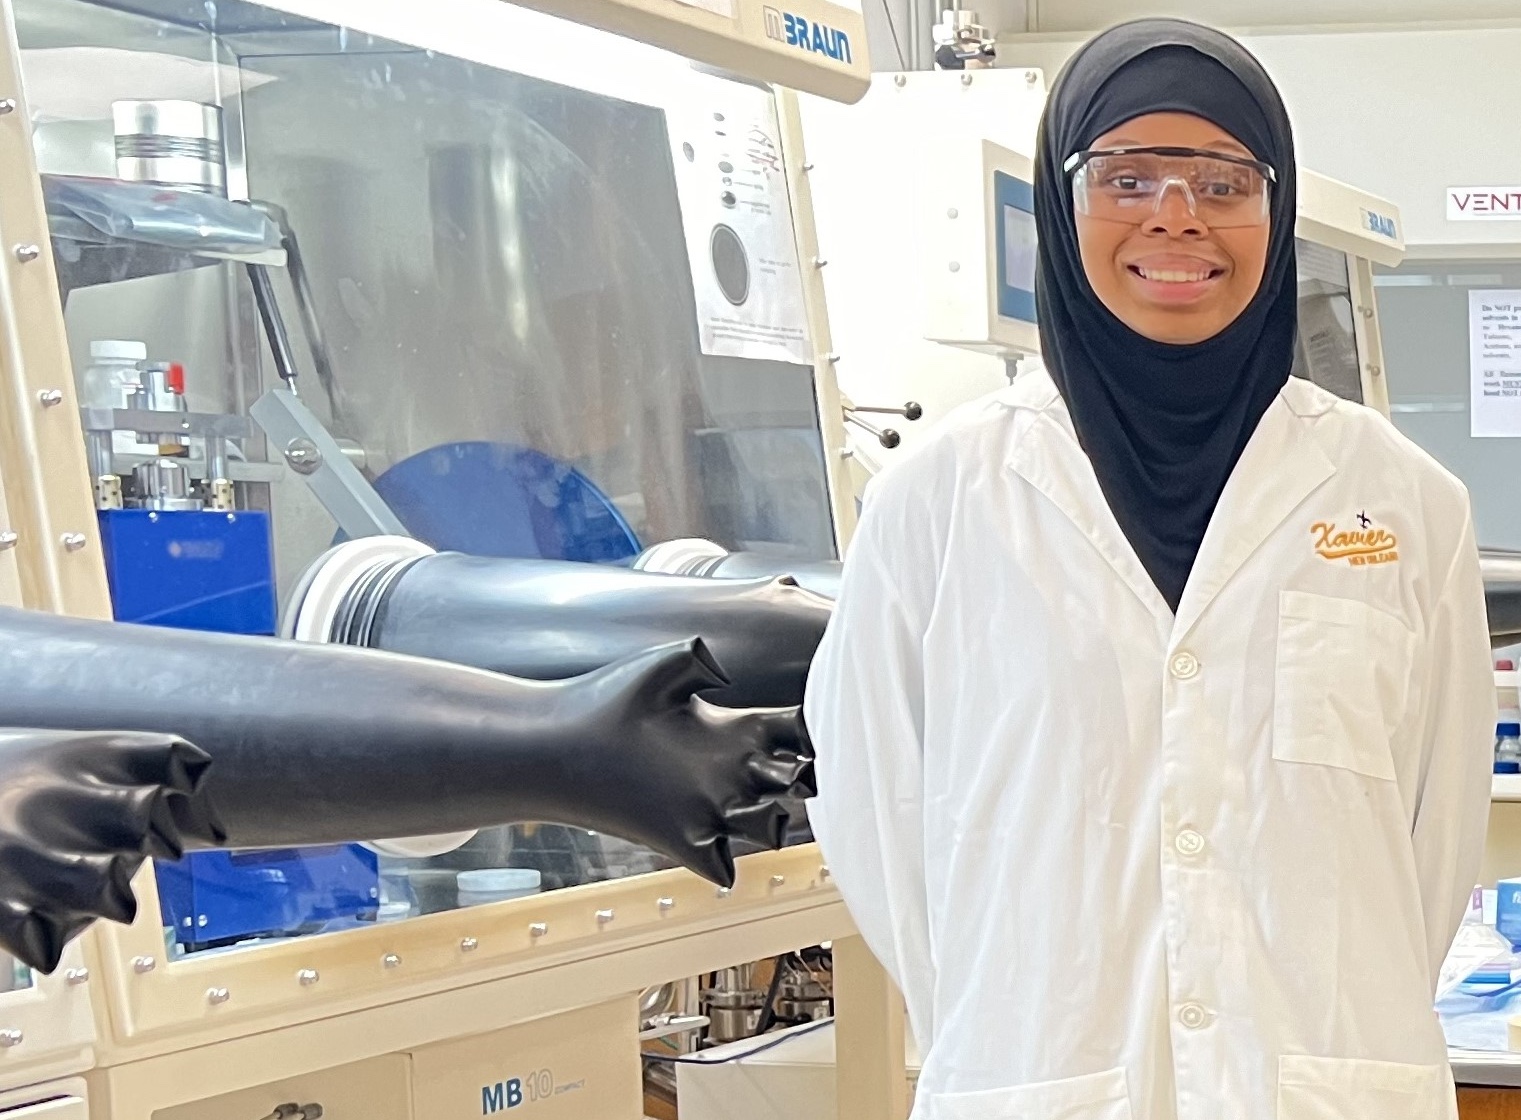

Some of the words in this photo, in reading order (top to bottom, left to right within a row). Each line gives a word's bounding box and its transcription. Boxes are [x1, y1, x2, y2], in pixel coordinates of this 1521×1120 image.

[1311, 523, 1396, 559] Xavier
[482, 1078, 522, 1115] MB
[526, 1069, 553, 1101] 10
